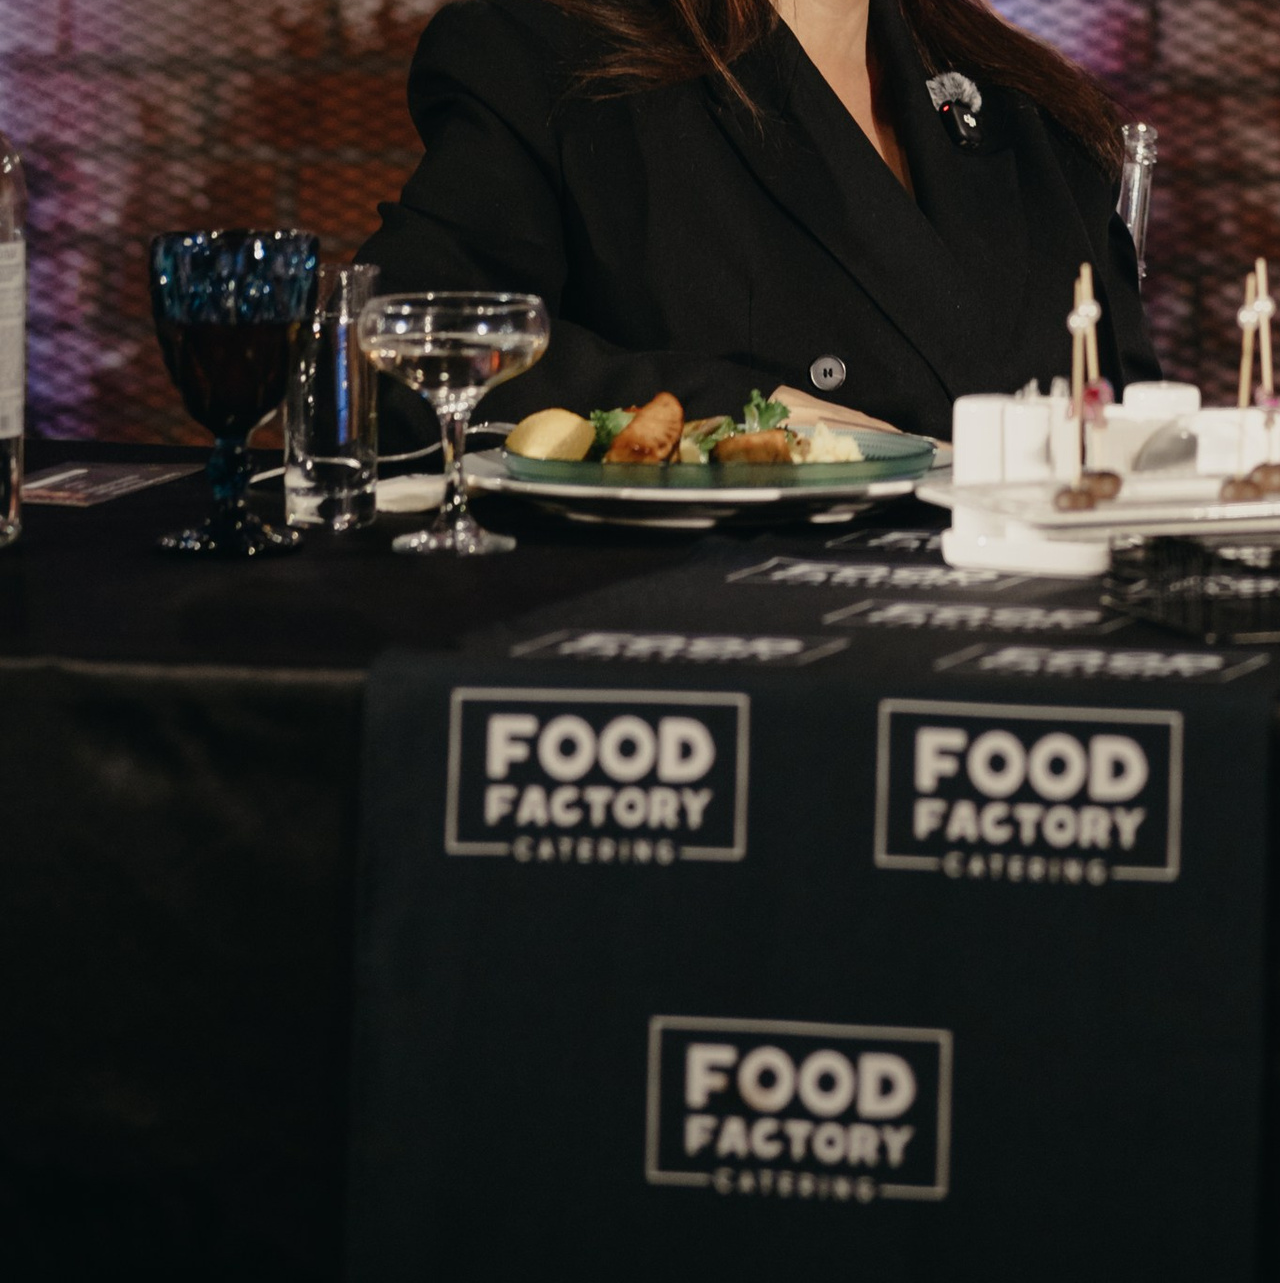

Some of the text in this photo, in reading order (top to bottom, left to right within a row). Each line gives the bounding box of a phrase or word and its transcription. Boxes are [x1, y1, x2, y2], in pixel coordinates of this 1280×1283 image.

[485, 713, 717, 784] FOOD
[913, 726, 1150, 803] FOOD
[484, 784, 713, 830] FACTORY
[912, 796, 1146, 851] FACTORY
[685, 1042, 917, 1120] FOOD
[684, 1113, 915, 1168] FACTORY
